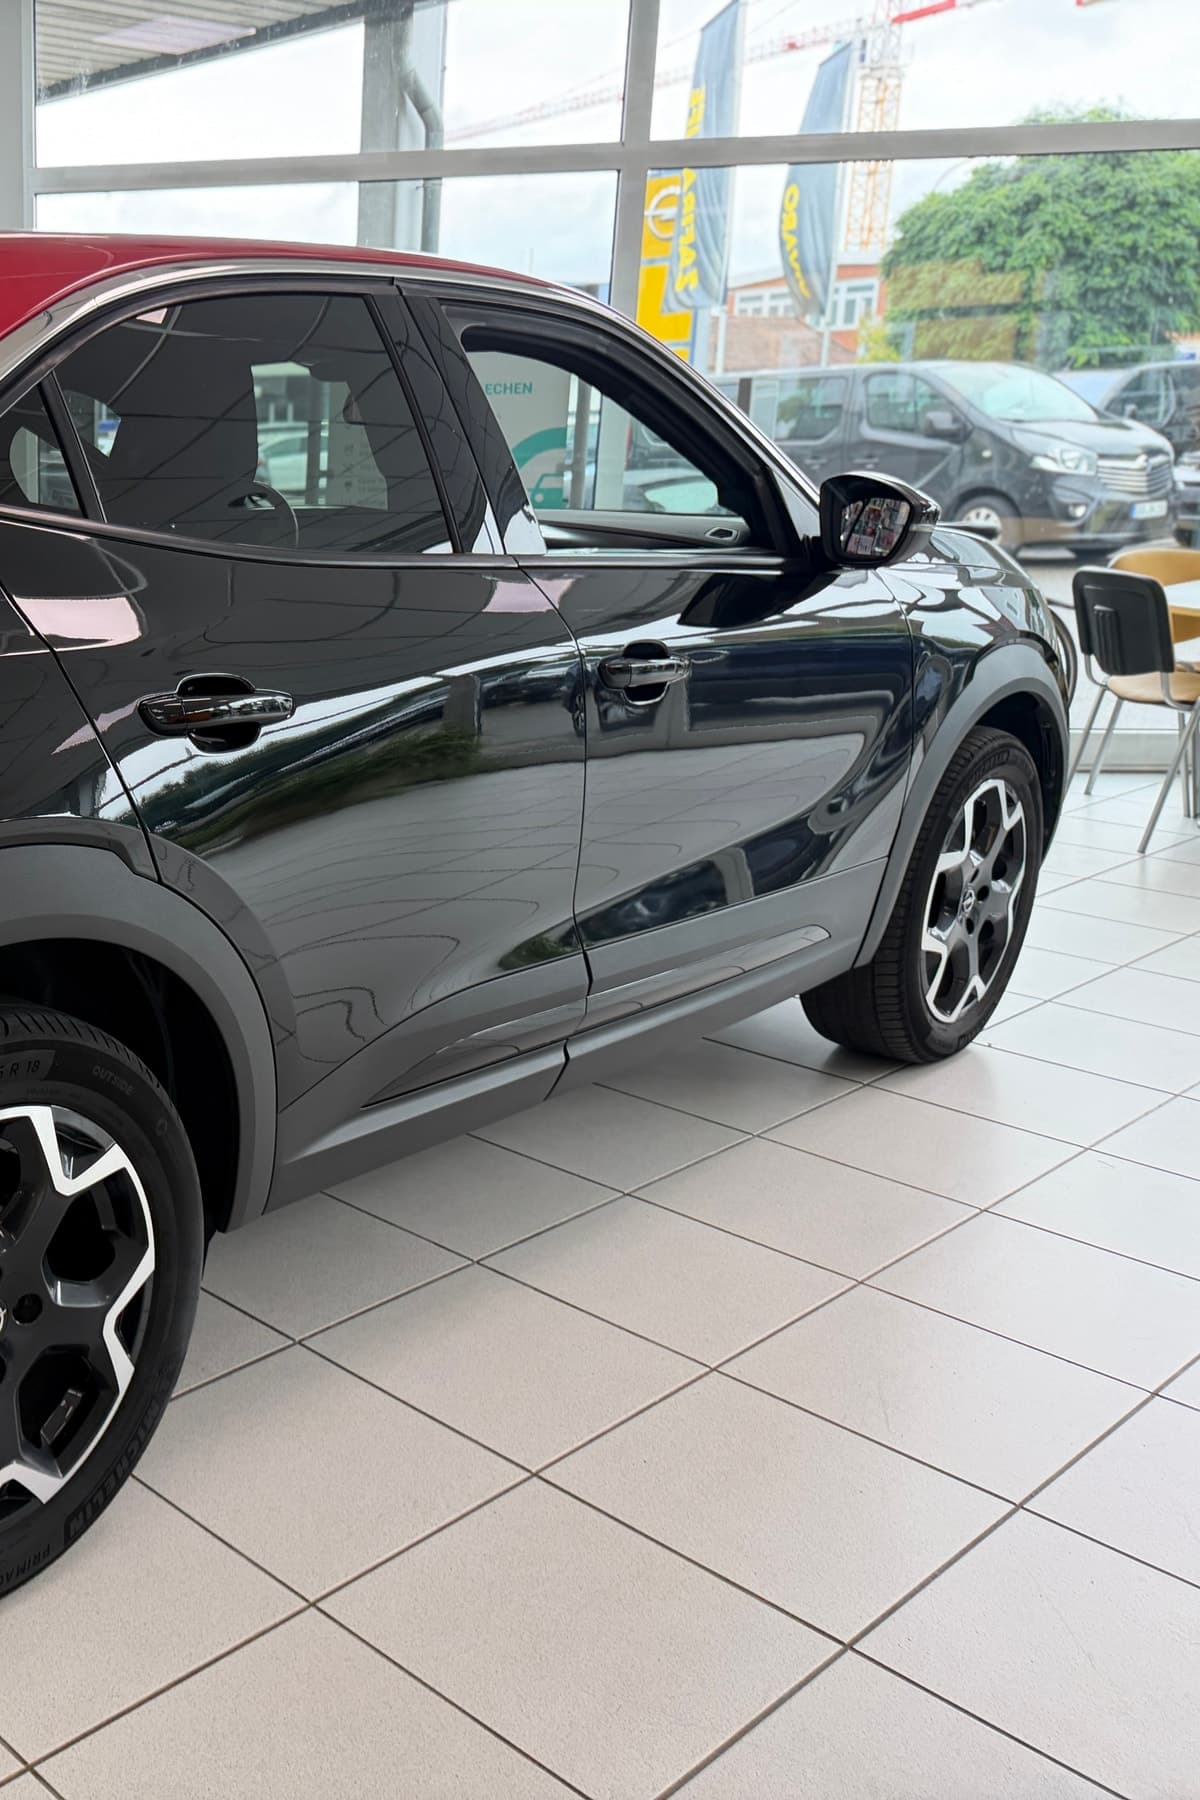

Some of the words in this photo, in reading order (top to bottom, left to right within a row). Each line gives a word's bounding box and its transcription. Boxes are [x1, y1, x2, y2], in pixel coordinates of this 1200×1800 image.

[8, 1063, 20, 1075] R
[26, 1059, 41, 1074] 18
[91, 1065, 136, 1096] OUTSIDE
[65, 1400, 162, 1540] MICHELIN
